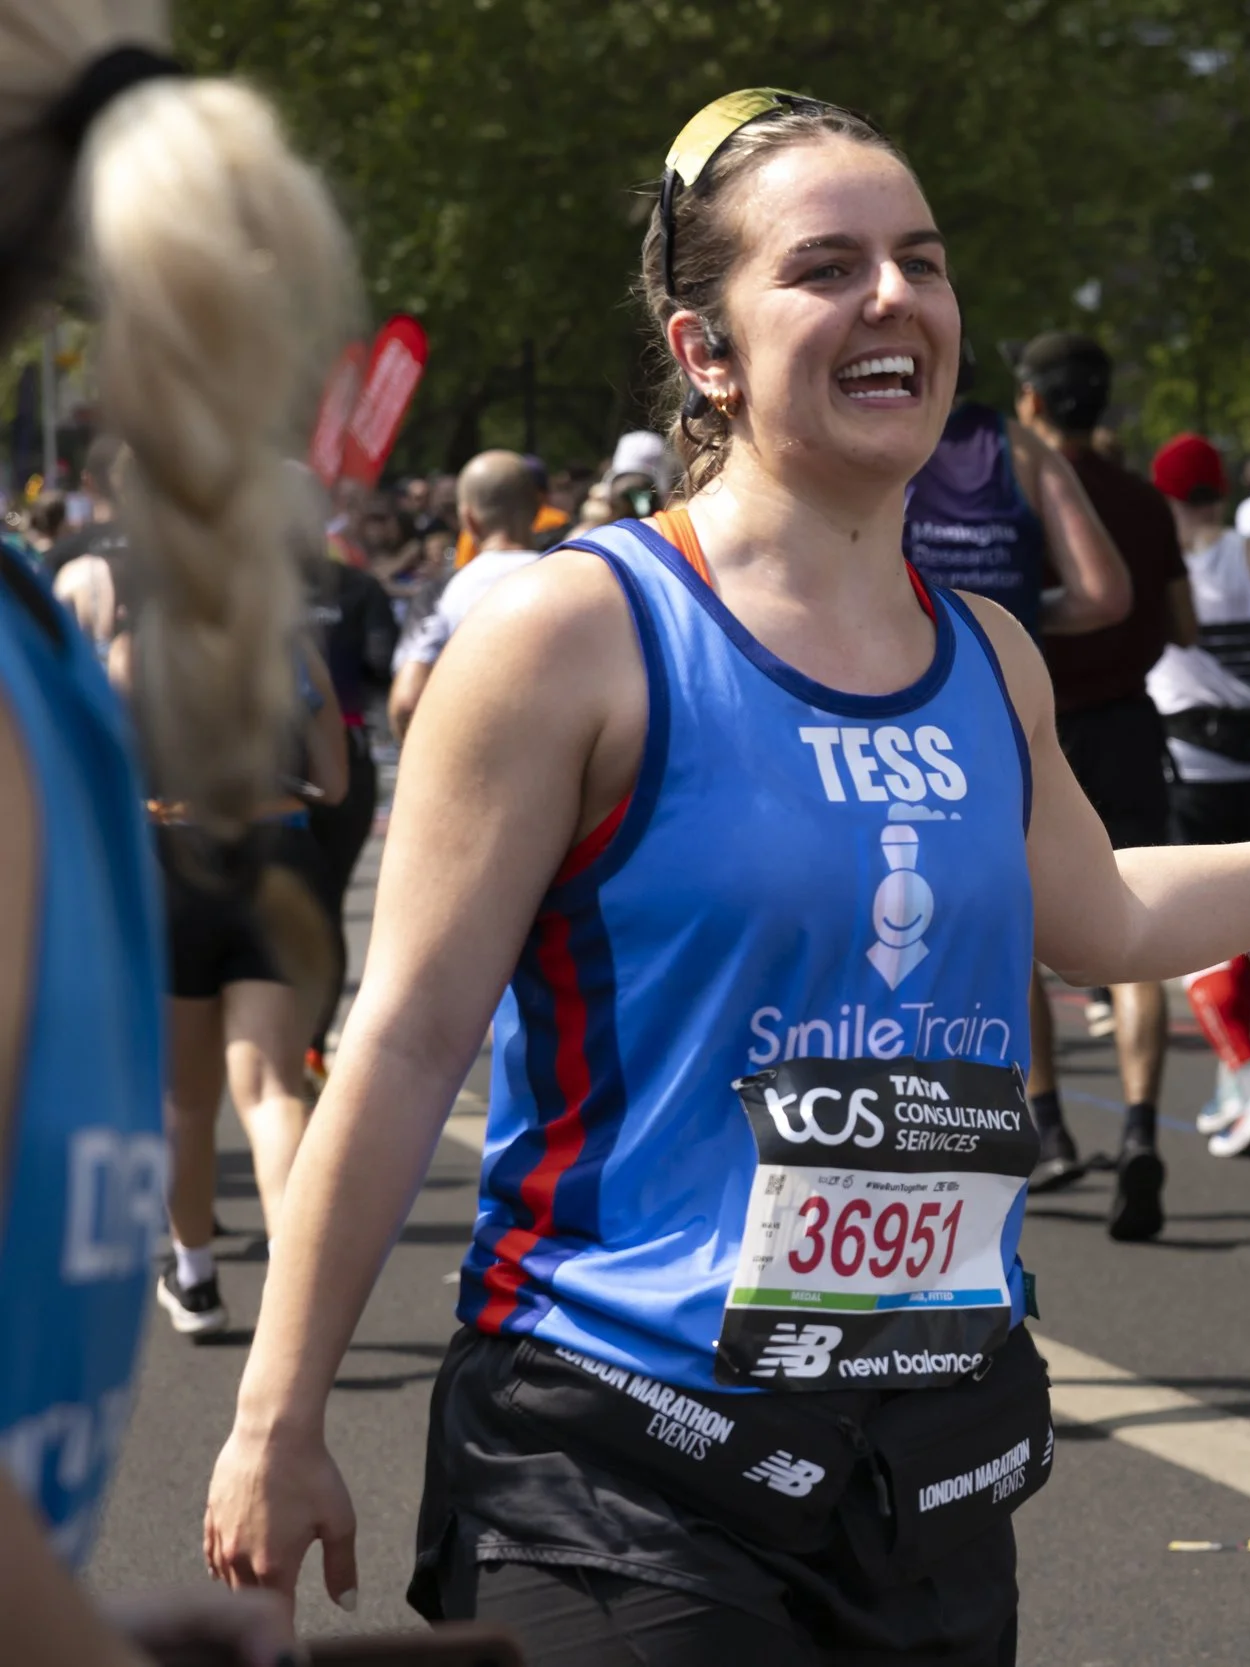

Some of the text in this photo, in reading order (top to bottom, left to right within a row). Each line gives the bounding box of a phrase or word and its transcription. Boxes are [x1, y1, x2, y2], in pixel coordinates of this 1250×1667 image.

[799, 725, 968, 803] TESS
[890, 1075, 950, 1101] TATA
[894, 1103, 1021, 1132] CONSULTANCY
[895, 1129, 980, 1152] SERVICES
[788, 1195, 964, 1279] 36951
[838, 1349, 984, 1378] new balance
[625, 1375, 735, 1444] MARATHON
[645, 1413, 712, 1461] EVENTS
[919, 1471, 973, 1513] LONDON
[974, 1437, 1030, 1492] MARATHON
[992, 1465, 1026, 1505] EVENTS
